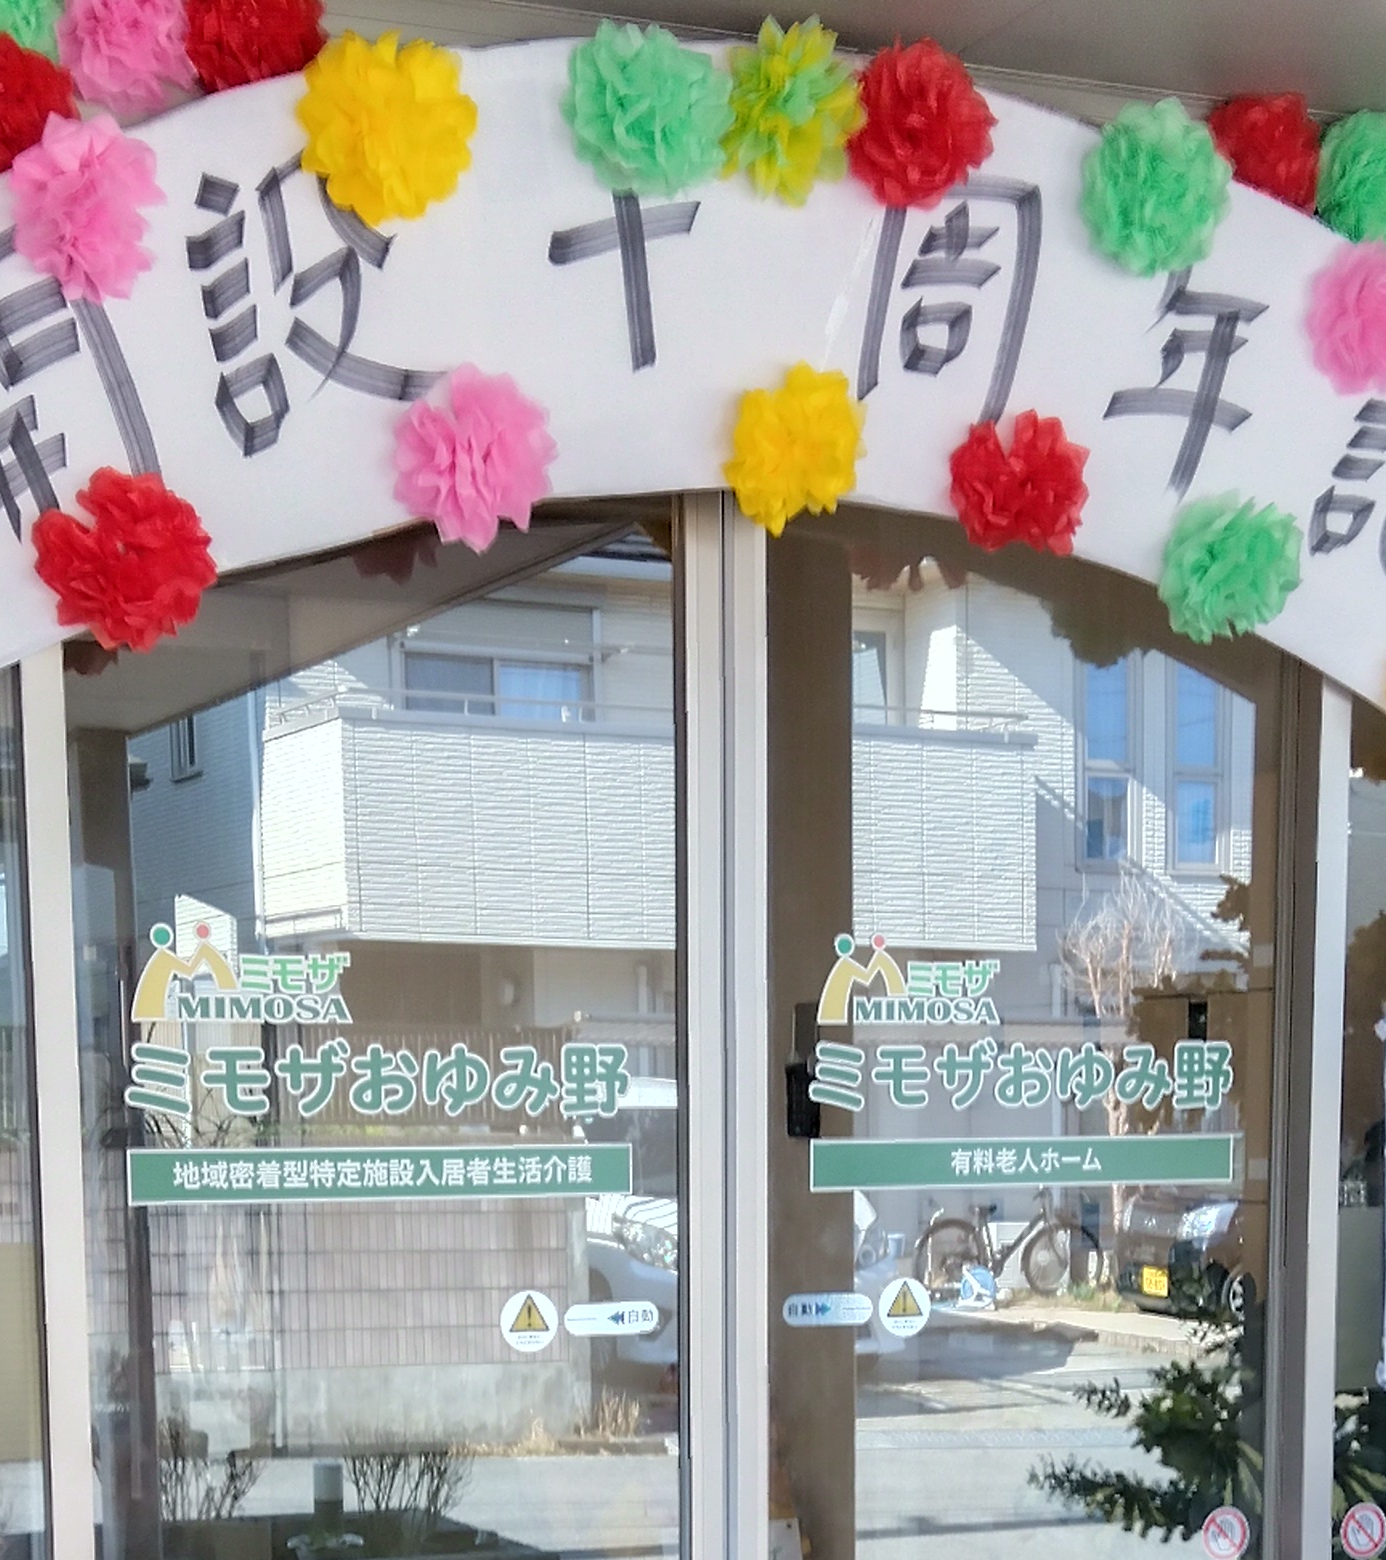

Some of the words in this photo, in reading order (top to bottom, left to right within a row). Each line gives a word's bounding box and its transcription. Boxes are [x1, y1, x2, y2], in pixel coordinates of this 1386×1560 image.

[239, 952, 351, 992] ミモザ
[906, 960, 1000, 997] ミモザ
[178, 994, 352, 1023] MIMOSA
[854, 997, 1000, 1025] MIMOSA
[126, 1038, 629, 1117] ミモザおゆみ野
[809, 1038, 1233, 1111] ミモザおゆみ野
[172, 1154, 593, 1192] 地域密着型特定施設入居者生活介護
[950, 1147, 1102, 1176] 有料老人ホーム
